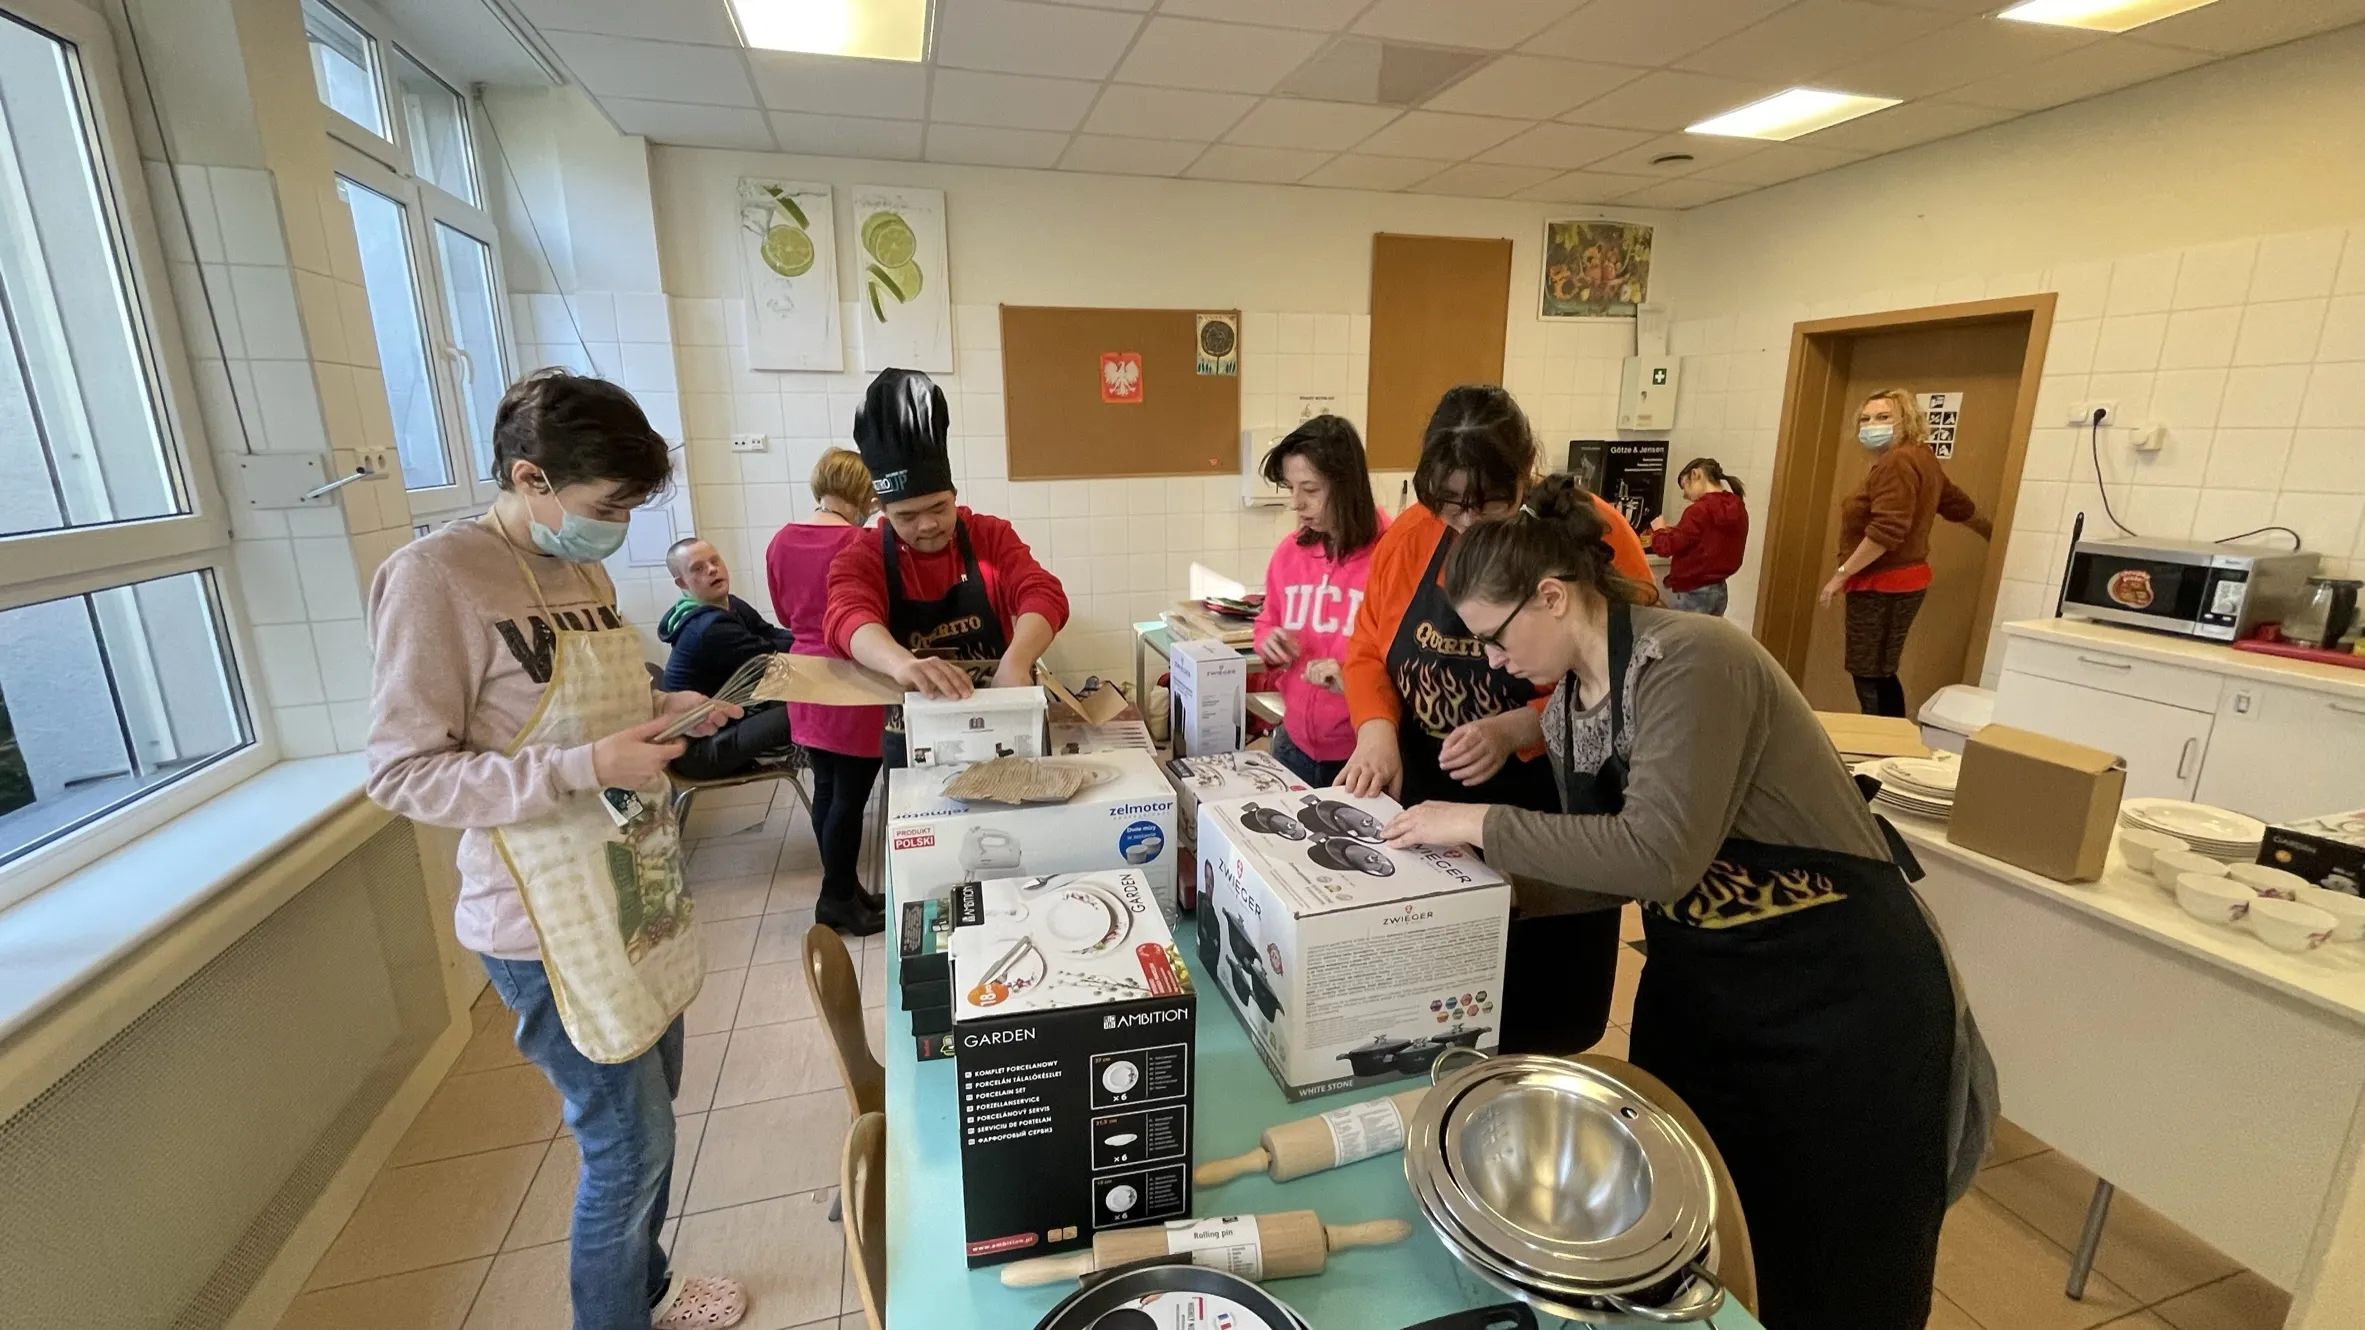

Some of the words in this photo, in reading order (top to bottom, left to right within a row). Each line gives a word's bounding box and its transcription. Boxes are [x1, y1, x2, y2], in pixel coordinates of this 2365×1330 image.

[1632, 446, 1638, 454] &
[1639, 446, 1665, 454] Jensen
[1109, 802, 1174, 816] zelmotor
[896, 827, 931, 837] PRODUKT
[895, 836, 934, 849] POLSKI
[1119, 874, 1146, 913] GARDEN
[1218, 856, 1262, 922] ZWIEGER
[961, 886, 975, 916] AMBITION
[1383, 911, 1433, 925] ZWIEGER
[1116, 1008, 1189, 1028] AMBITION
[963, 1027, 1036, 1048] GARDEN
[975, 1067, 1005, 1077] KOMPLET
[1006, 1060, 1058, 1073] PORCELANOWY
[975, 1077, 1012, 1089] PORCELÁN
[976, 1088, 1014, 1100] PORCELAIN
[1121, 1093, 1127, 1101] 6
[1299, 1084, 1326, 1098] WHITE
[976, 1096, 1040, 1111] PORZELLANSERVICE
[976, 1109, 1027, 1122] PORCELÁNOVÝ
[1028, 1105, 1050, 1115] SERVIS
[977, 1123, 1008, 1133] SERVICIU
[978, 1129, 1027, 1144] ФАРФОРОВЫЙ
[1028, 1127, 1053, 1137] СЕРВИЗ
[1121, 1153, 1128, 1161] 6
[1121, 1212, 1128, 1220] 6
[1193, 1231, 1220, 1240] Rolling
[1221, 1229, 1234, 1238] pin
[972, 1236, 1033, 1252] www.ambition.pl
